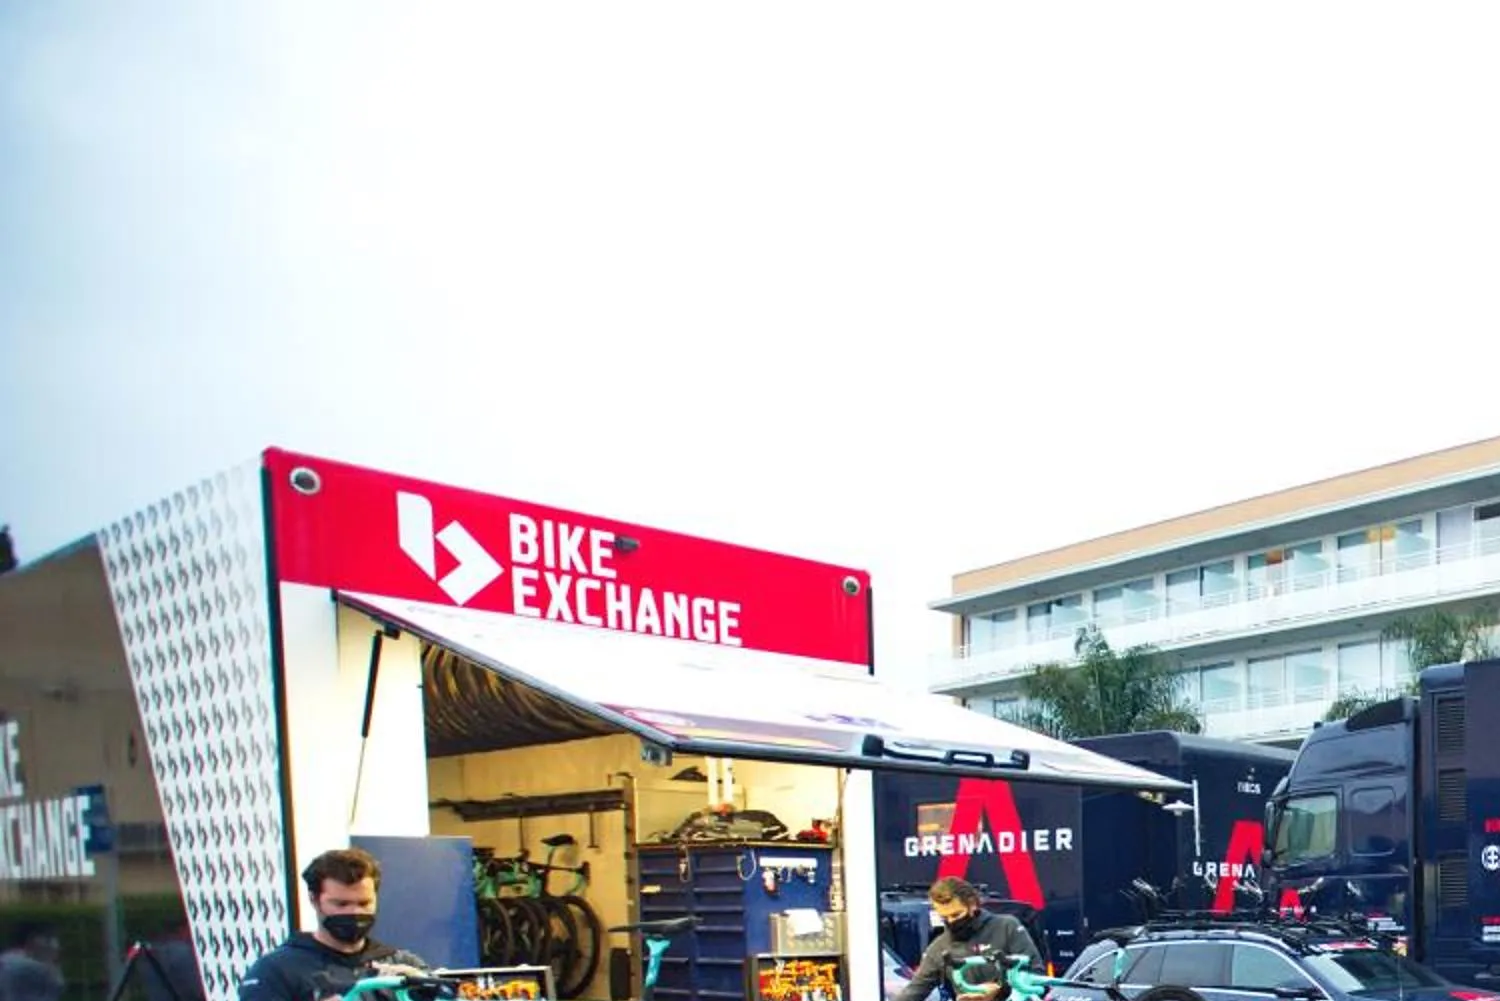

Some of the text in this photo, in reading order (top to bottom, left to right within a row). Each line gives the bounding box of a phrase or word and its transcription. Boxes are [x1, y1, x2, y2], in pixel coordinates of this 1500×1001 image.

[509, 512, 619, 579] BIKE
[511, 566, 743, 647] EXCHANGE
[904, 827, 1074, 857] GRENADIER
[1193, 861, 1256, 878] GRENA
